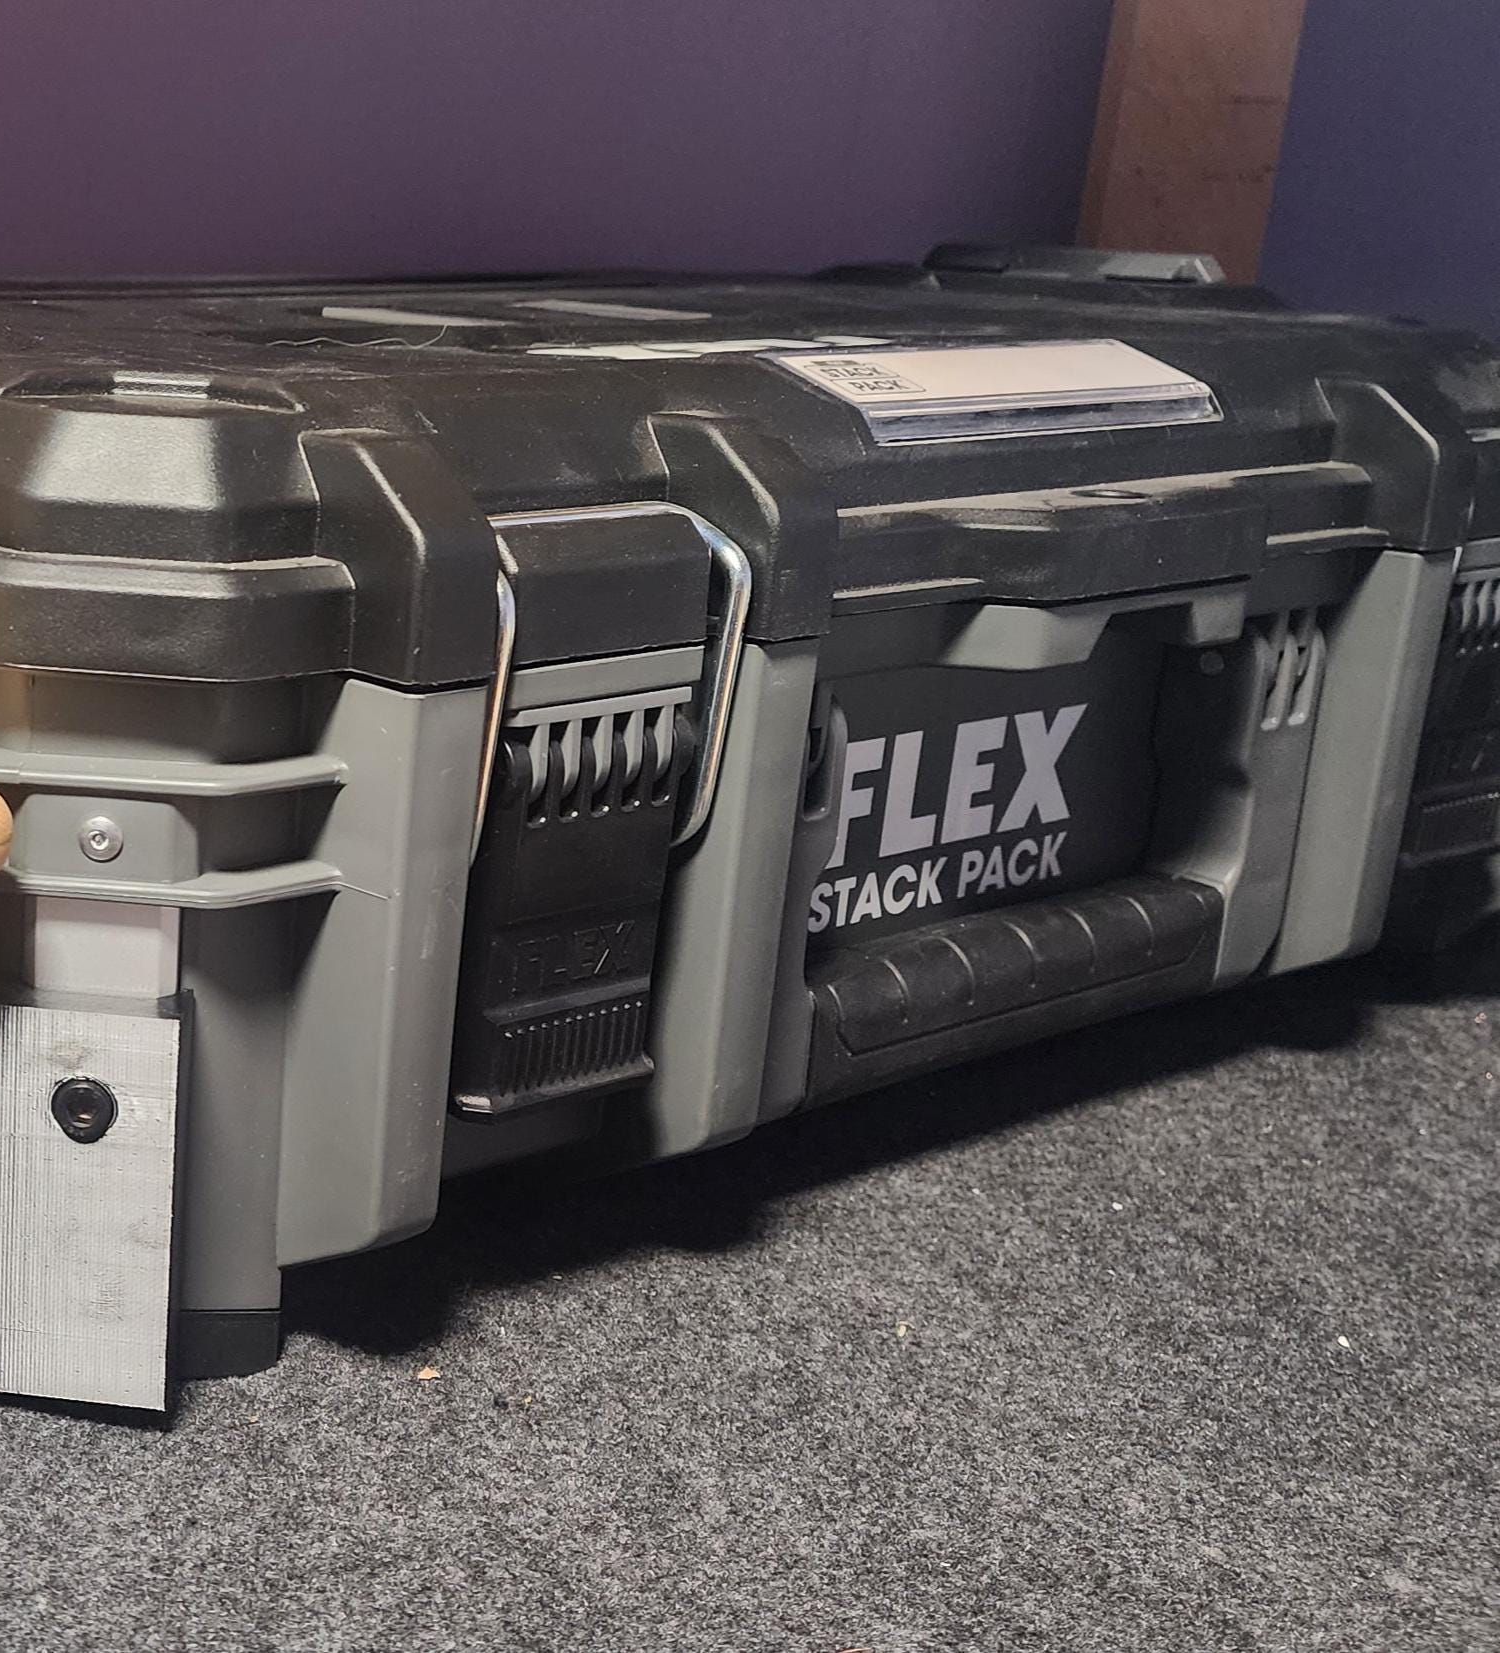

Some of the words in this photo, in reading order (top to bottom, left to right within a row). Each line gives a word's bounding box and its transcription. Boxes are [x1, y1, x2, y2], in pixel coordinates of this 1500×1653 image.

[848, 380, 911, 392] PACK
[825, 703, 1089, 870] FLEX
[808, 857, 948, 934] STACK
[957, 831, 1067, 899] PACK
[511, 919, 636, 993] FLEX
